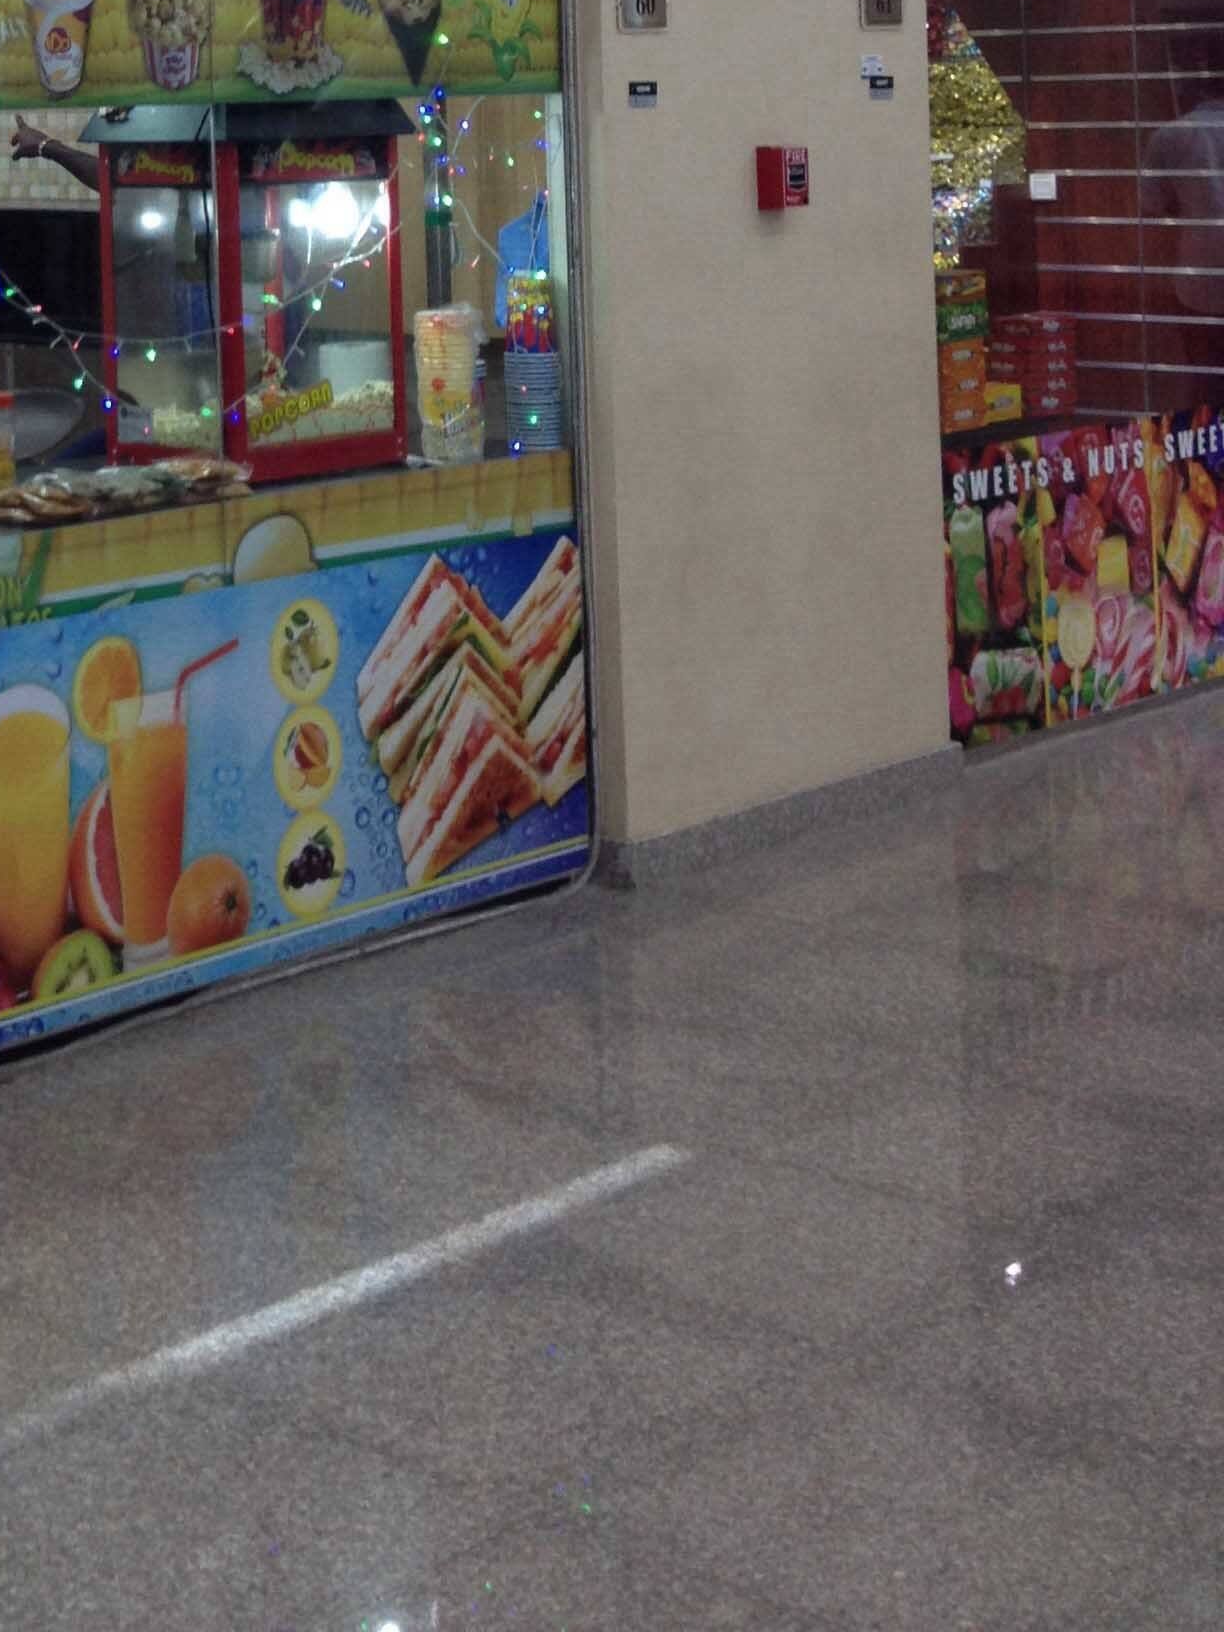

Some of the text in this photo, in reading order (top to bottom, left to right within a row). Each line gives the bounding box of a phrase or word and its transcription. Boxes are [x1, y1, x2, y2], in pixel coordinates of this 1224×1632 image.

[248, 379, 333, 440] POPCORN
[952, 456, 1049, 504] SWEETS
[1061, 456, 1075, 483] &
[1087, 438, 1145, 477] NUTS
